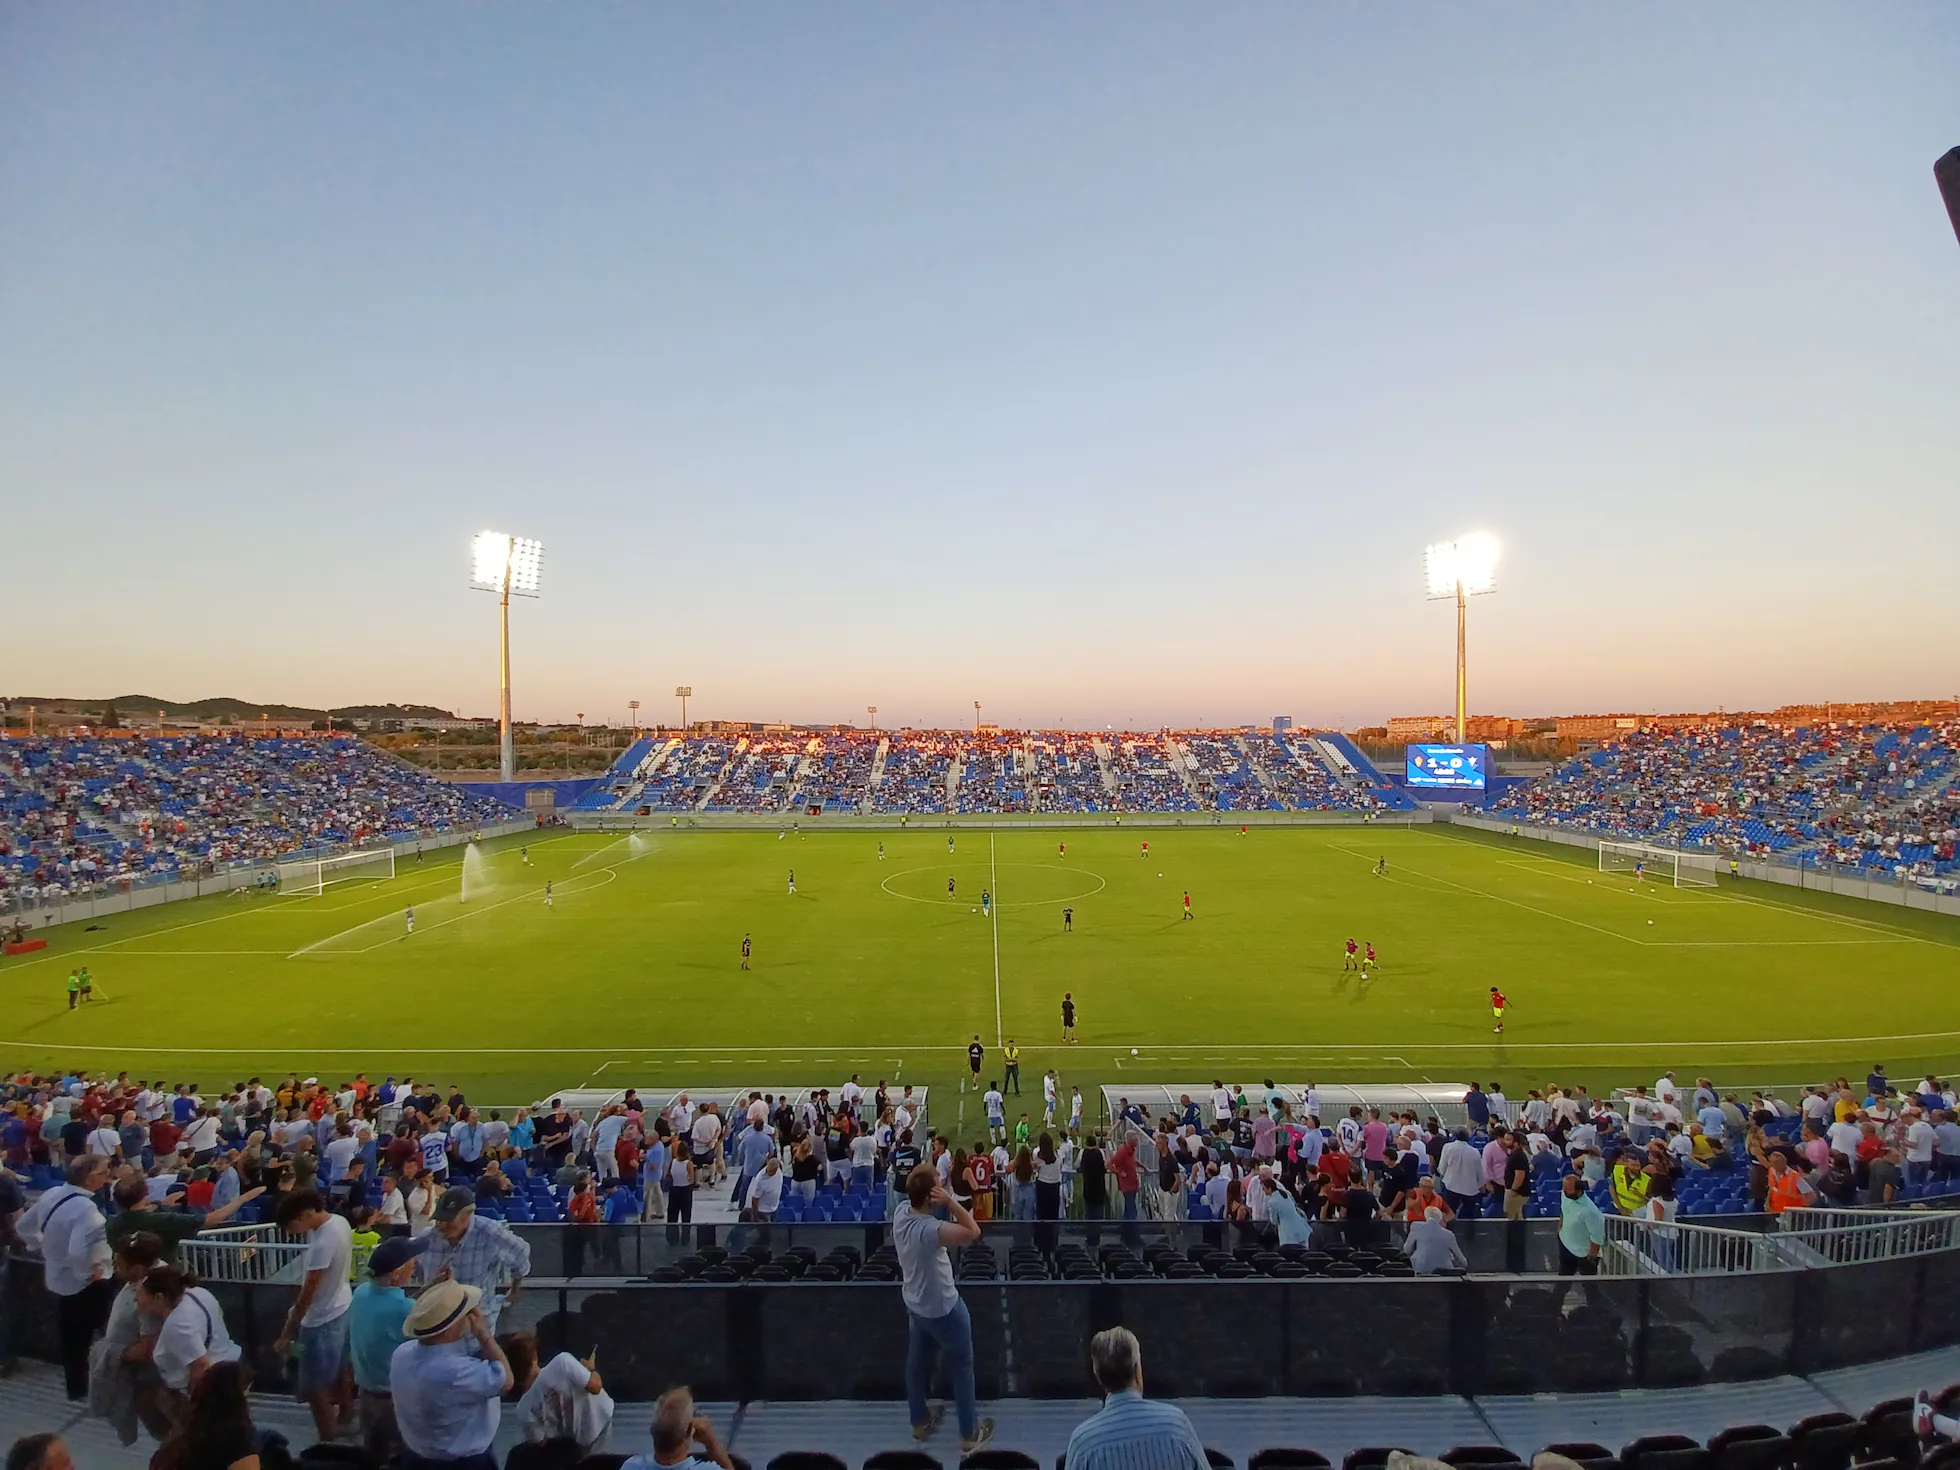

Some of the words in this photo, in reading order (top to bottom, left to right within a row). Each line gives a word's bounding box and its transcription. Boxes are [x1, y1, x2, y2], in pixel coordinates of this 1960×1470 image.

[1450, 758, 1462, 768] 0
[1342, 1126, 1354, 1142] 14
[425, 1144, 442, 1159] 23
[975, 1162, 985, 1181] 6
